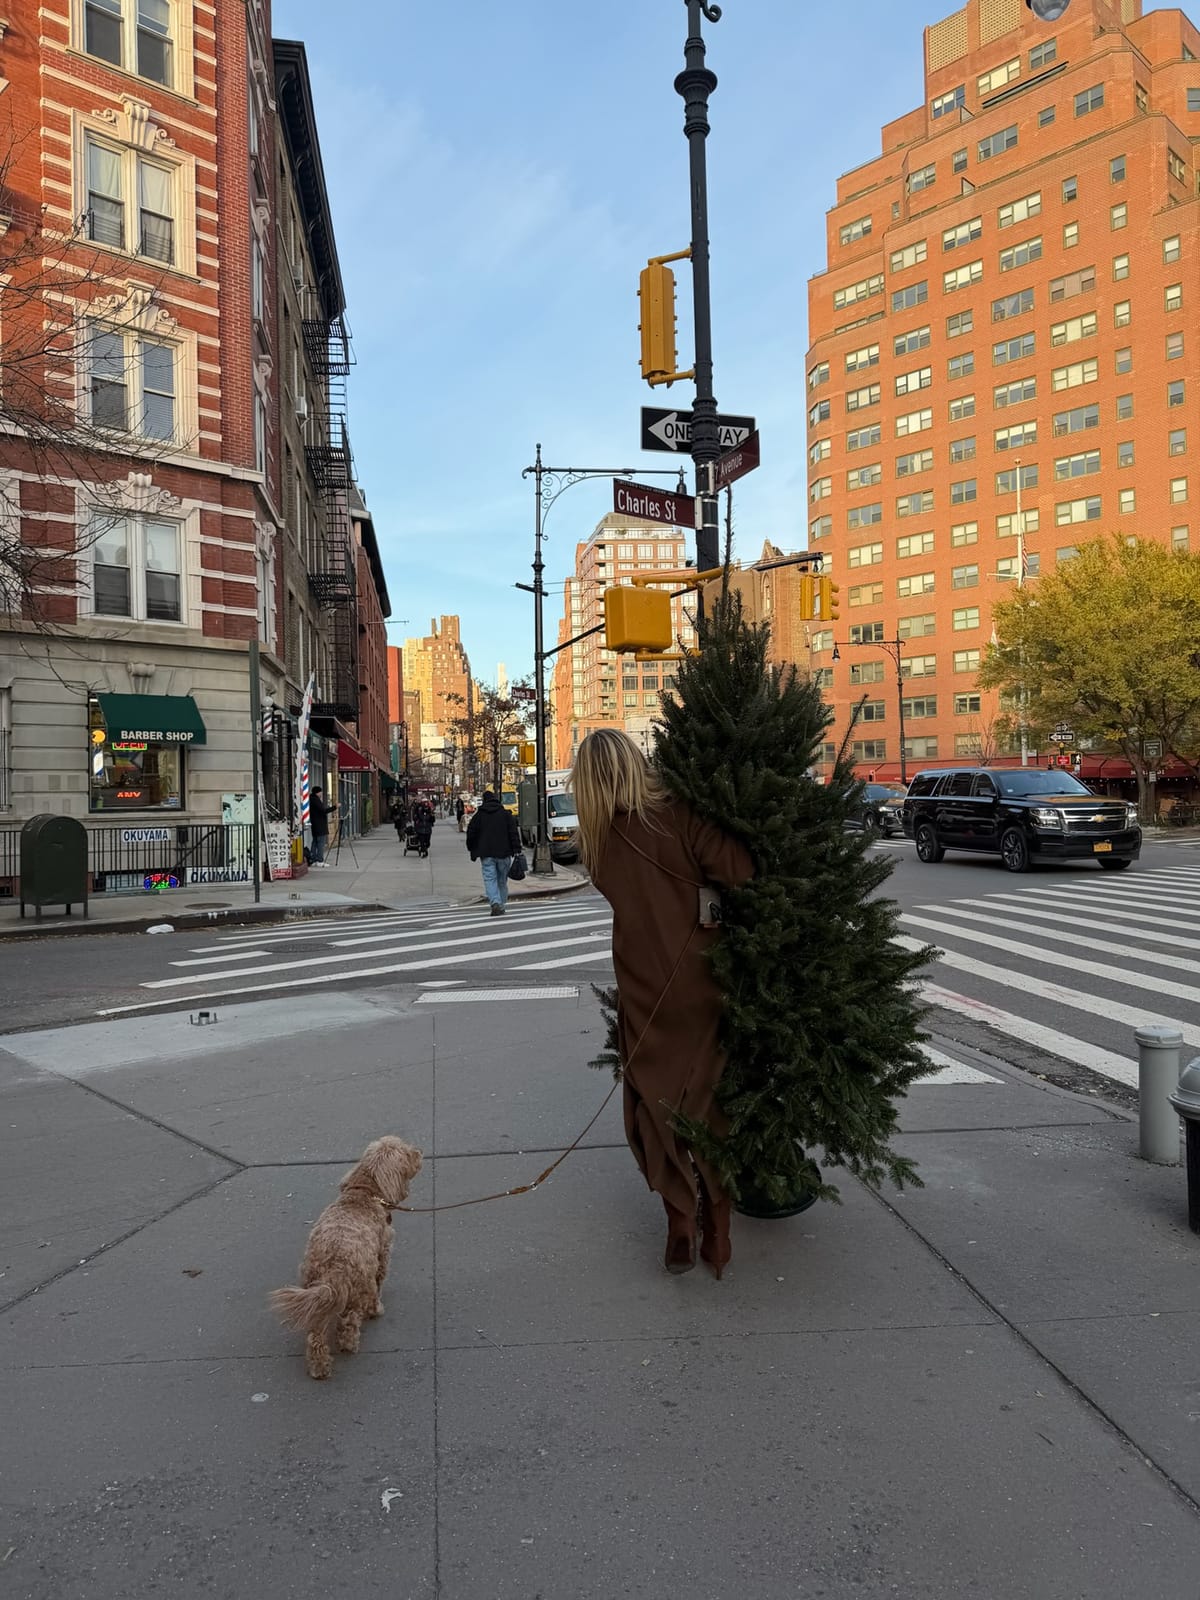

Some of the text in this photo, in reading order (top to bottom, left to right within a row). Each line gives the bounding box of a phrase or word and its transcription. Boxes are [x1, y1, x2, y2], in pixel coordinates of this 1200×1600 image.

[664, 422, 743, 445] ONE AY
[721, 454, 743, 477] Avenue
[617, 489, 676, 522] Charles St
[121, 730, 194, 741] BARBER SHOP
[123, 829, 169, 841] OKUYAMA
[190, 870, 248, 883] OKUYAMA
